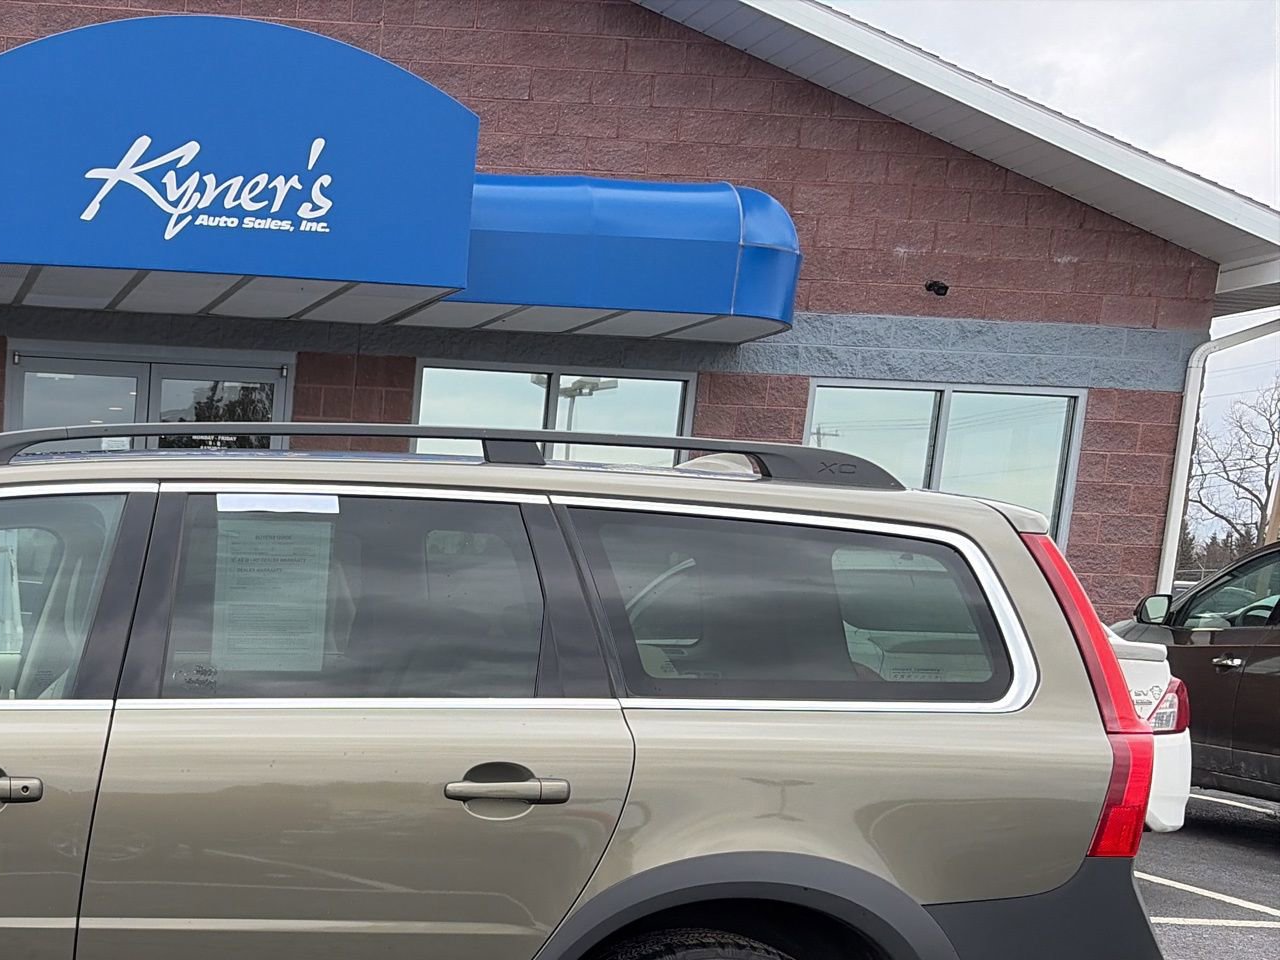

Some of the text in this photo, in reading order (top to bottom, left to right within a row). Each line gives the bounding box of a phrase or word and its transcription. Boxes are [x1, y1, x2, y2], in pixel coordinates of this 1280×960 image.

[79, 134, 334, 241] Kyner's
[194, 214, 331, 233] Auto Sales, Inc.
[818, 461, 857, 475] XC
